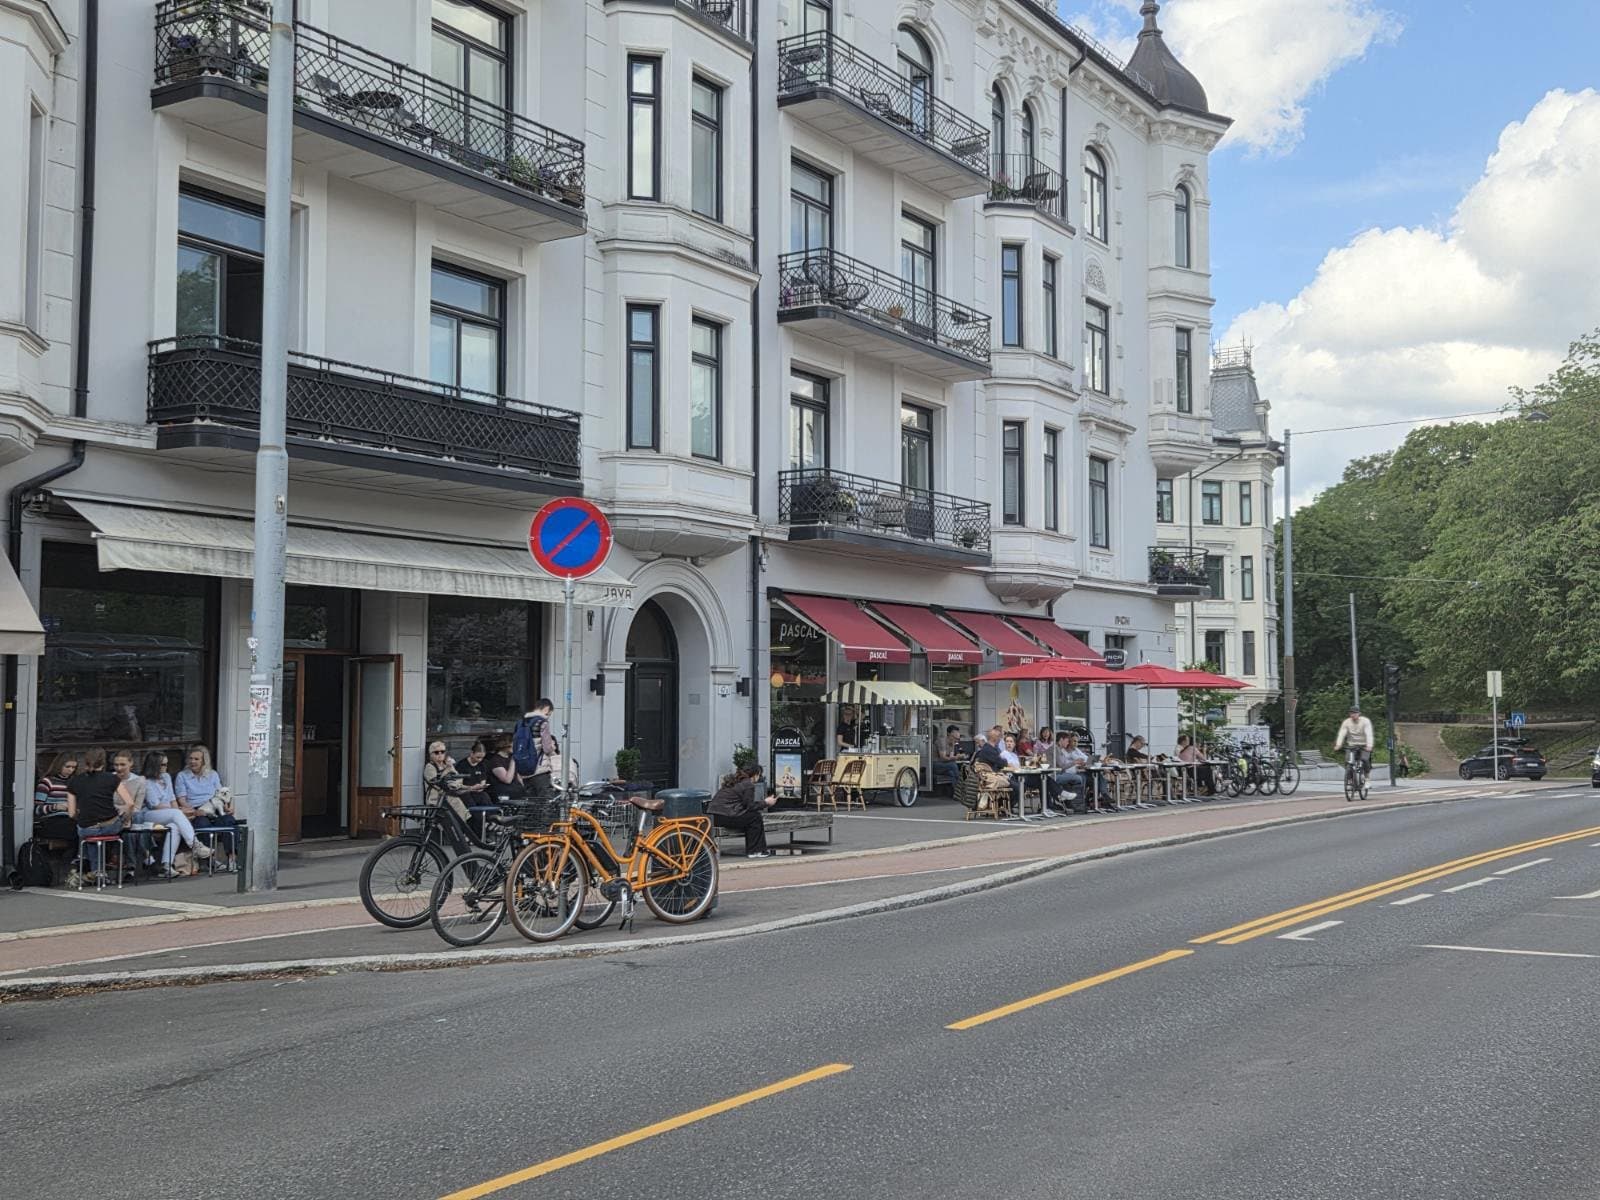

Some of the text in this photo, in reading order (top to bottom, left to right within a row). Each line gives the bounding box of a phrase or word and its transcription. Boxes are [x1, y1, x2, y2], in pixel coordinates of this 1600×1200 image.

[604, 587, 632, 599] JAVA
[779, 623, 818, 641] PASCAL
[869, 651, 888, 661] PASCAL
[948, 653, 964, 661] PASCAL
[776, 737, 801, 746] PASCAL
